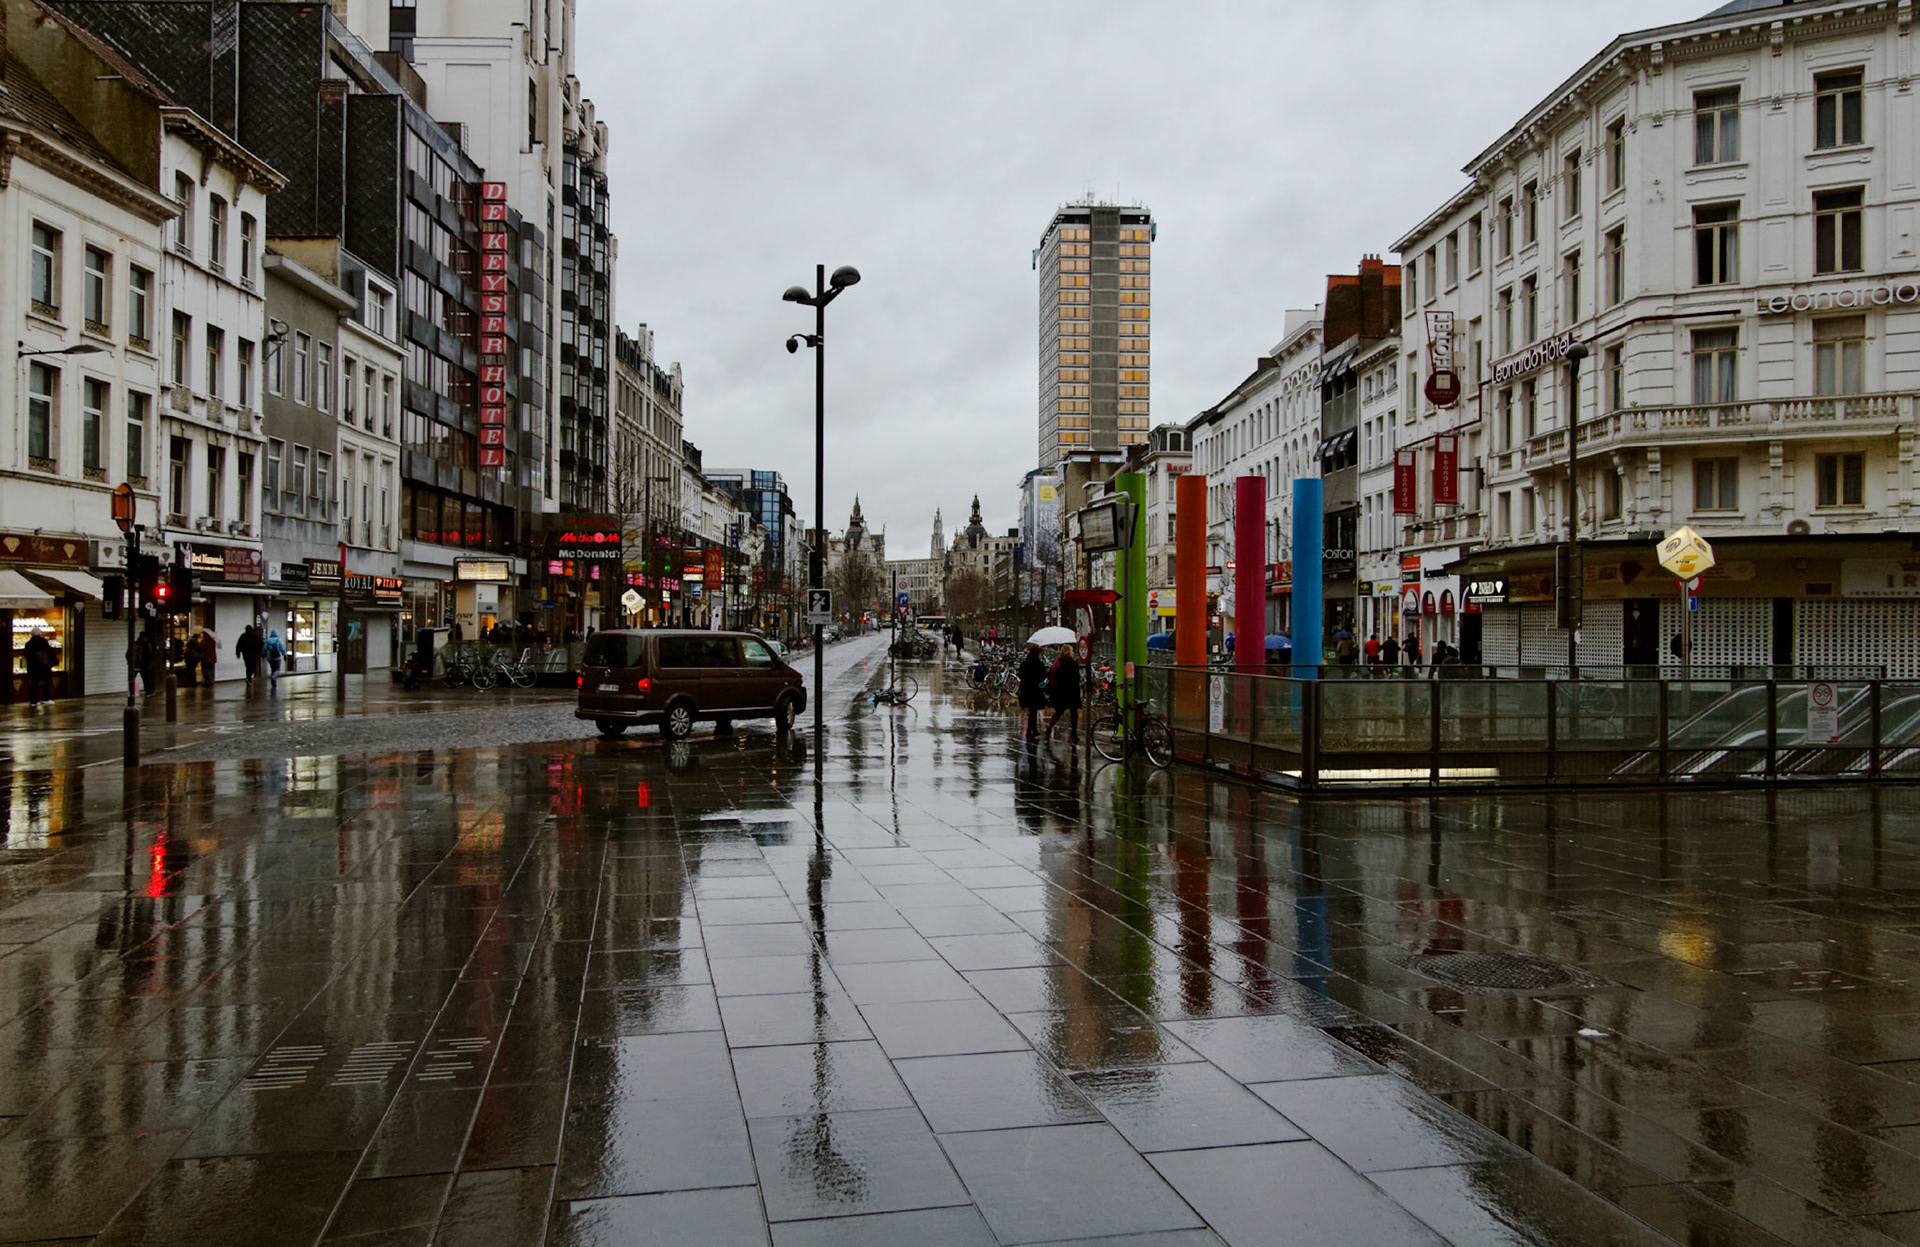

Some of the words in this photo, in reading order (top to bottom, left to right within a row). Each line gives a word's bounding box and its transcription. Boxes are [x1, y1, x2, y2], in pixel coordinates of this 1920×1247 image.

[486, 183, 503, 220] DE
[485, 234, 504, 353] KEYSER
[1754, 277, 1919, 315] Leonardo
[1434, 314, 1451, 372] HOTEL
[1492, 347, 1539, 385] Leonardo
[1540, 331, 1574, 364] Hotel
[484, 366, 503, 466] HOTEL
[312, 562, 338, 575] JENNY
[344, 576, 373, 590] ROYAL
